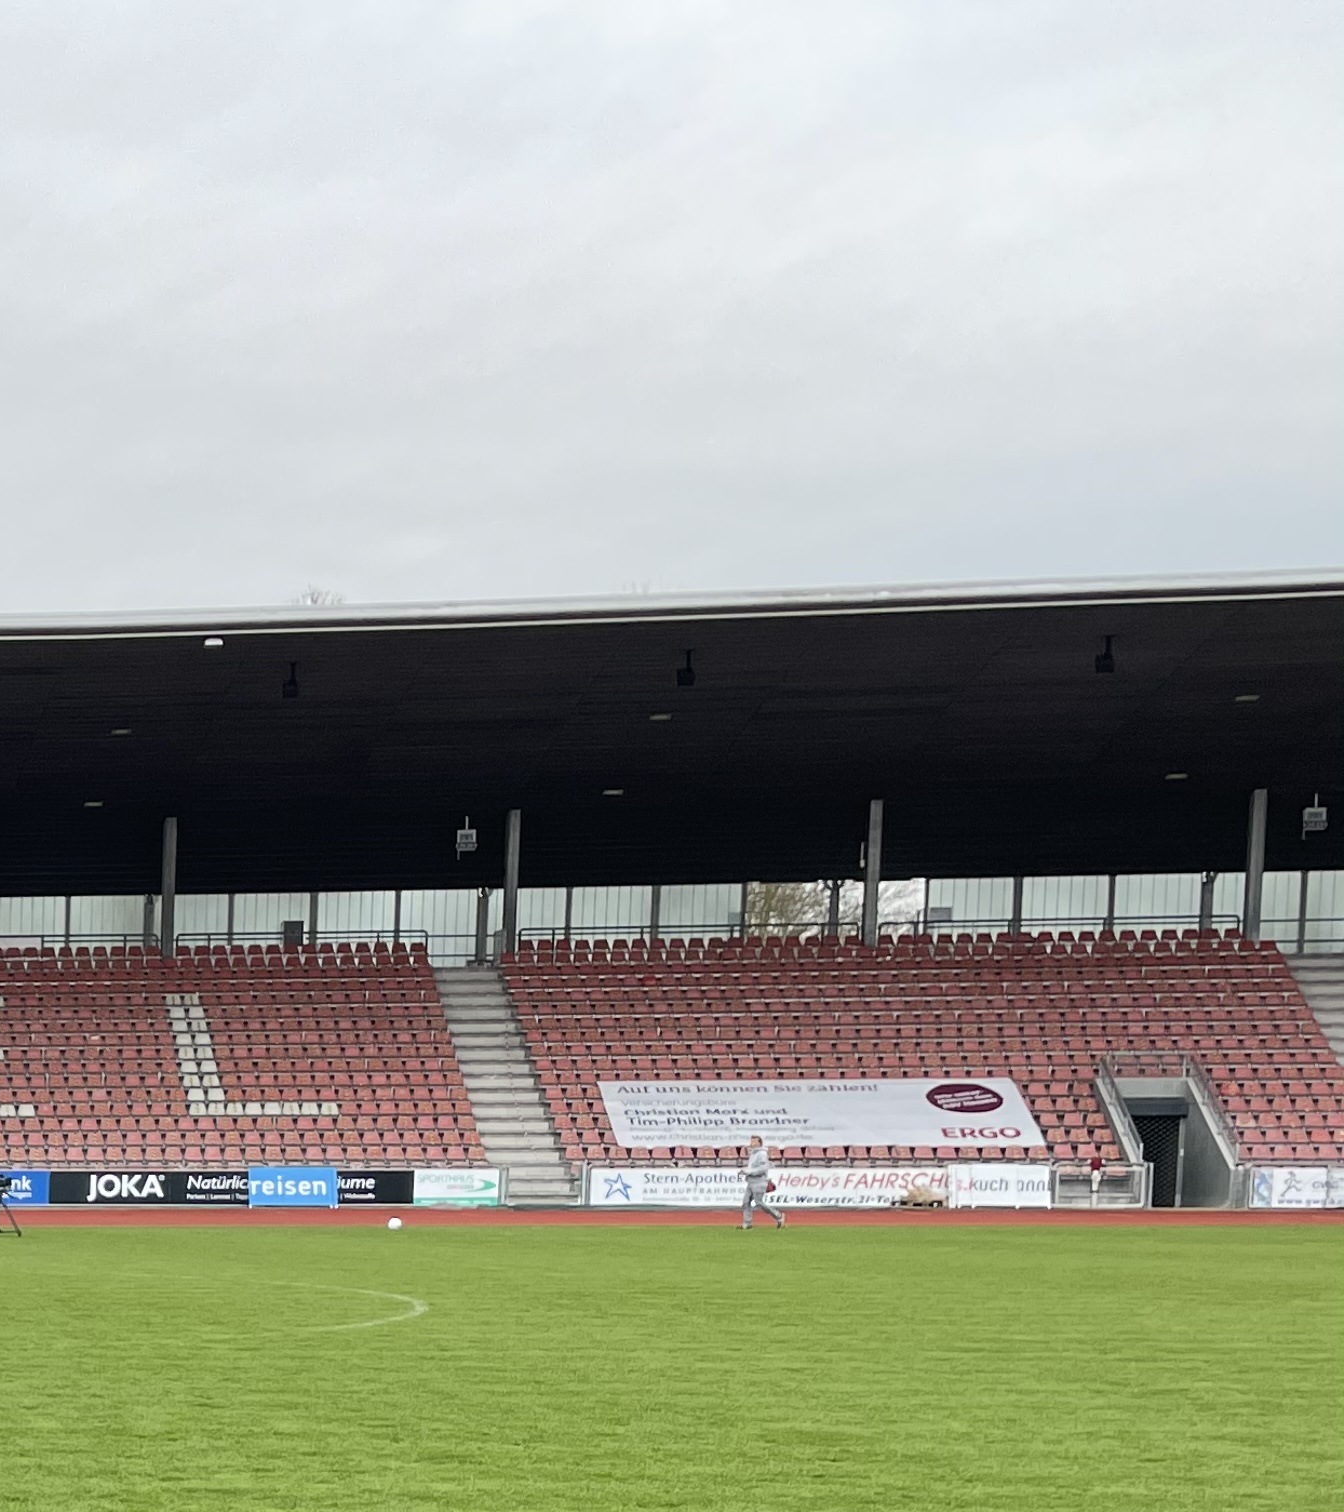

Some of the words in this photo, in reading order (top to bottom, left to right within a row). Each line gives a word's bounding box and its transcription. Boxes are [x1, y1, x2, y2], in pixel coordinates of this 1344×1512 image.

[656, 1086, 691, 1094] uns
[623, 1108, 701, 1116] Christian
[628, 1117, 725, 1126] Tim-Philipp
[941, 1127, 1021, 1138] ERGO
[249, 1175, 327, 1195] reisen
[778, 1173, 841, 1190] Herby's
[85, 1174, 165, 1202] JOKA
